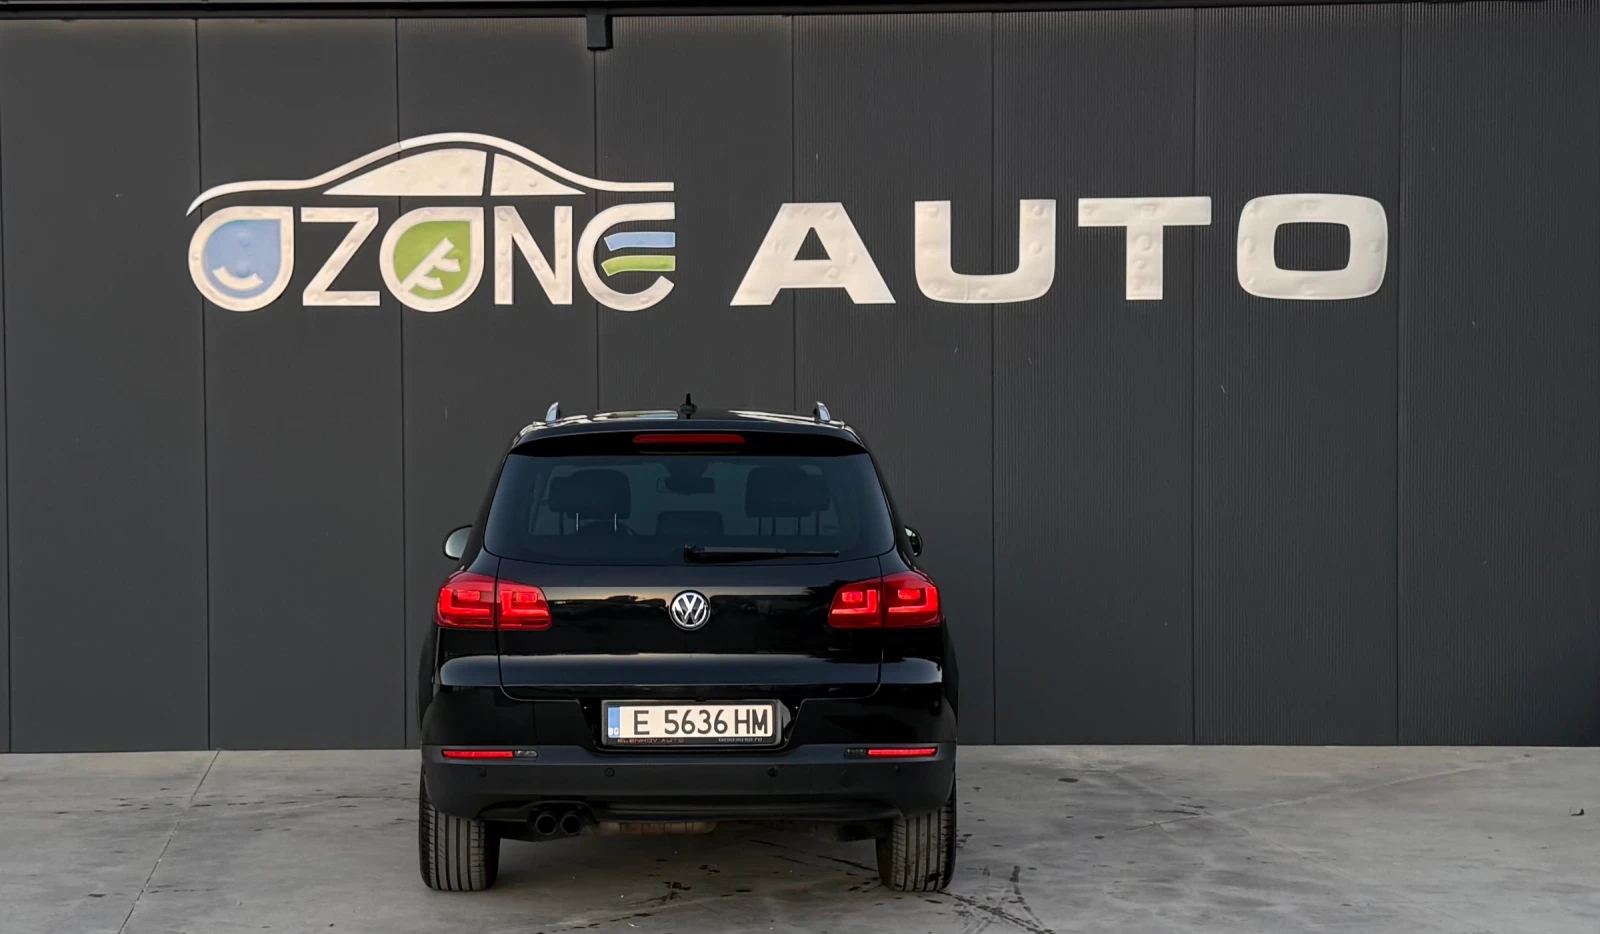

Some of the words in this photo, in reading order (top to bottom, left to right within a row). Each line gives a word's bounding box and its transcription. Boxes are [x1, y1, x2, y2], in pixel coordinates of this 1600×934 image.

[188, 202, 675, 312] OZONE
[730, 193, 1388, 306] AUTO
[670, 591, 708, 628] VW
[633, 709, 650, 735] E
[664, 709, 728, 735] 5636
[734, 709, 768, 735] HM
